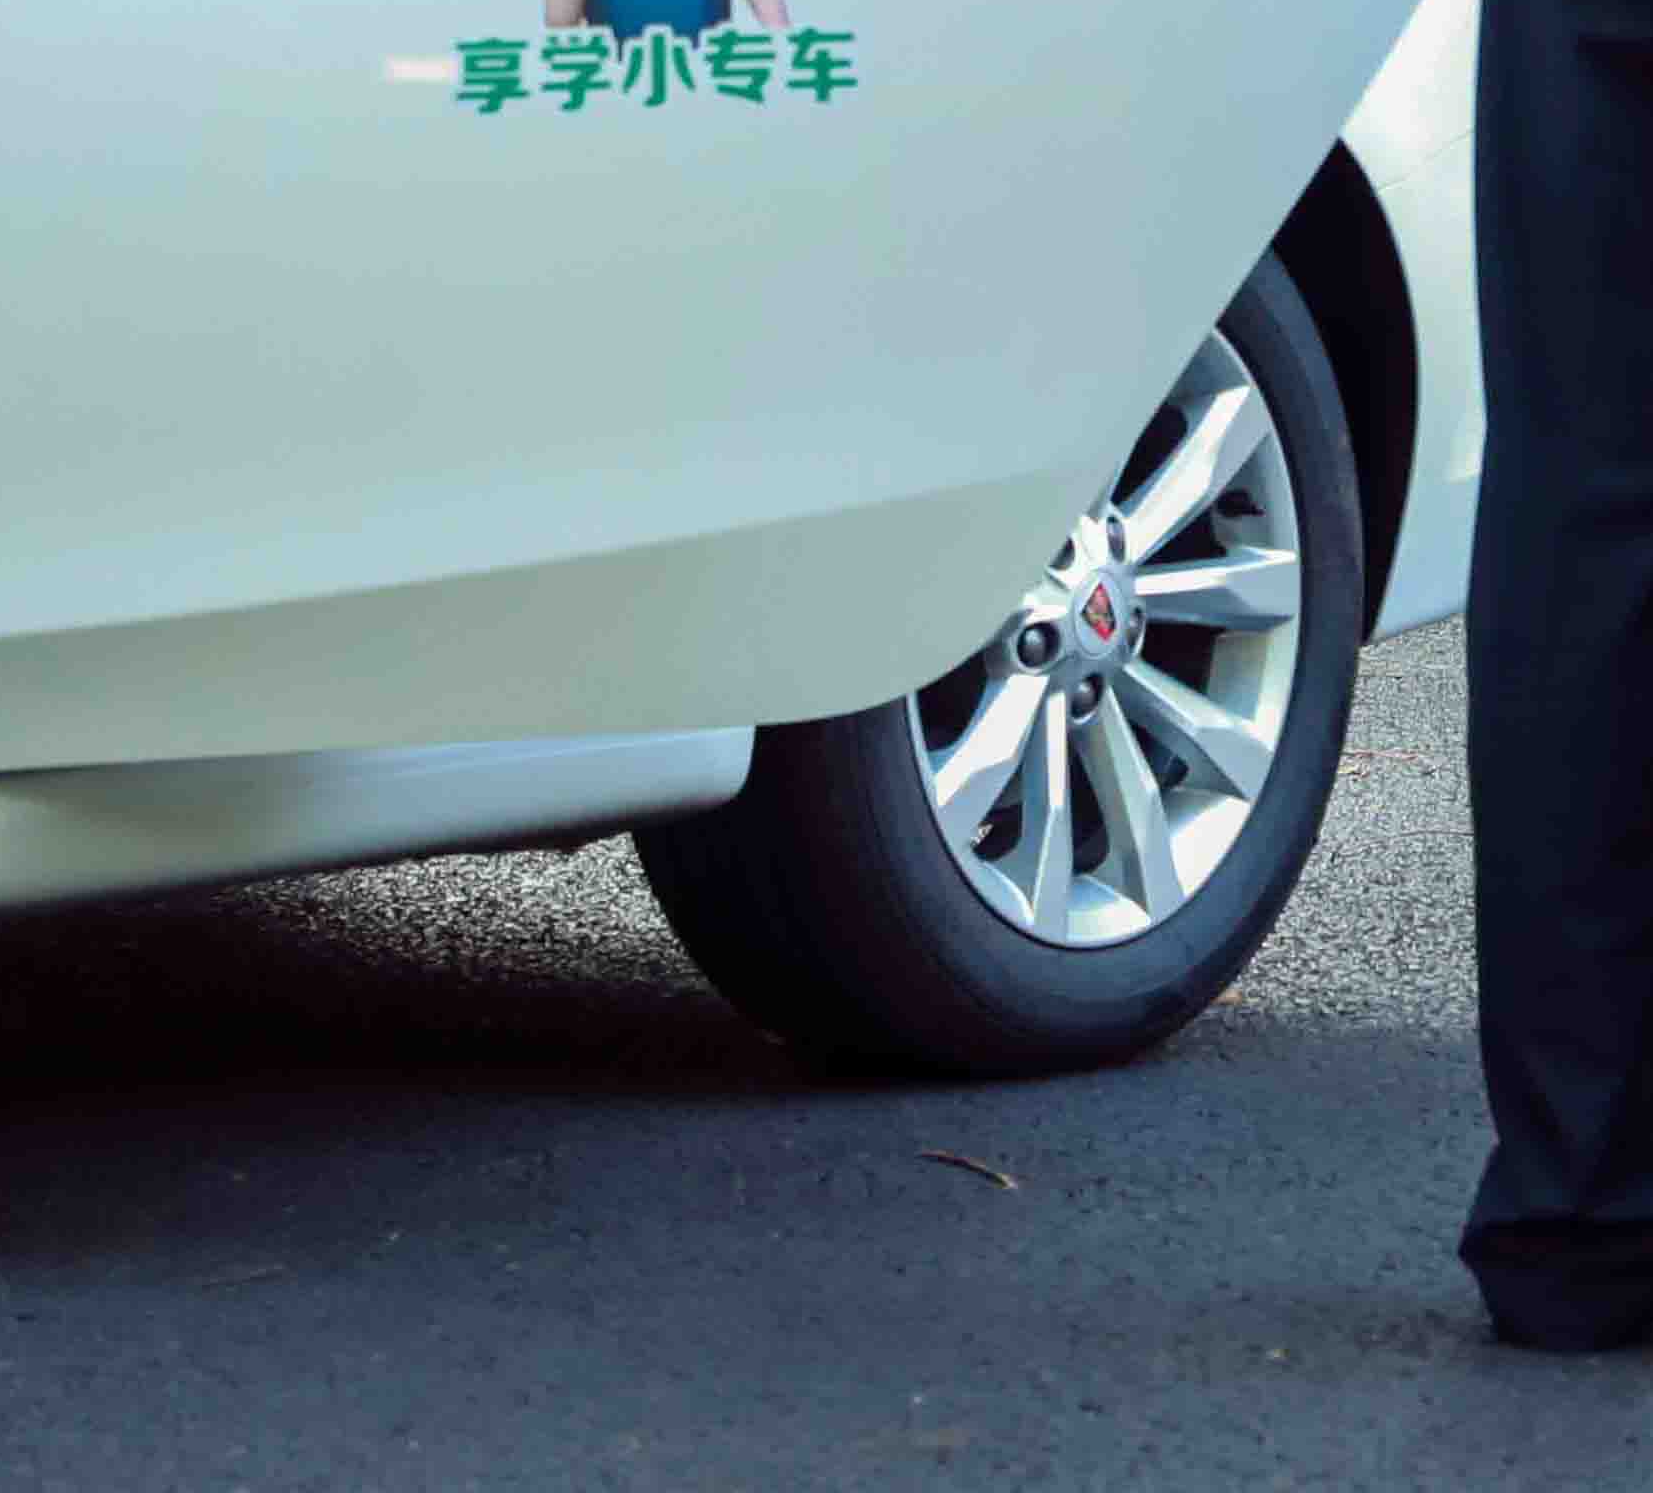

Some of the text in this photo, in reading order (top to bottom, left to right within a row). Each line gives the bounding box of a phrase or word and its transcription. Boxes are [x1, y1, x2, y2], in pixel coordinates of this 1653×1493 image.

[456, 27, 858, 114] 享学小专车
